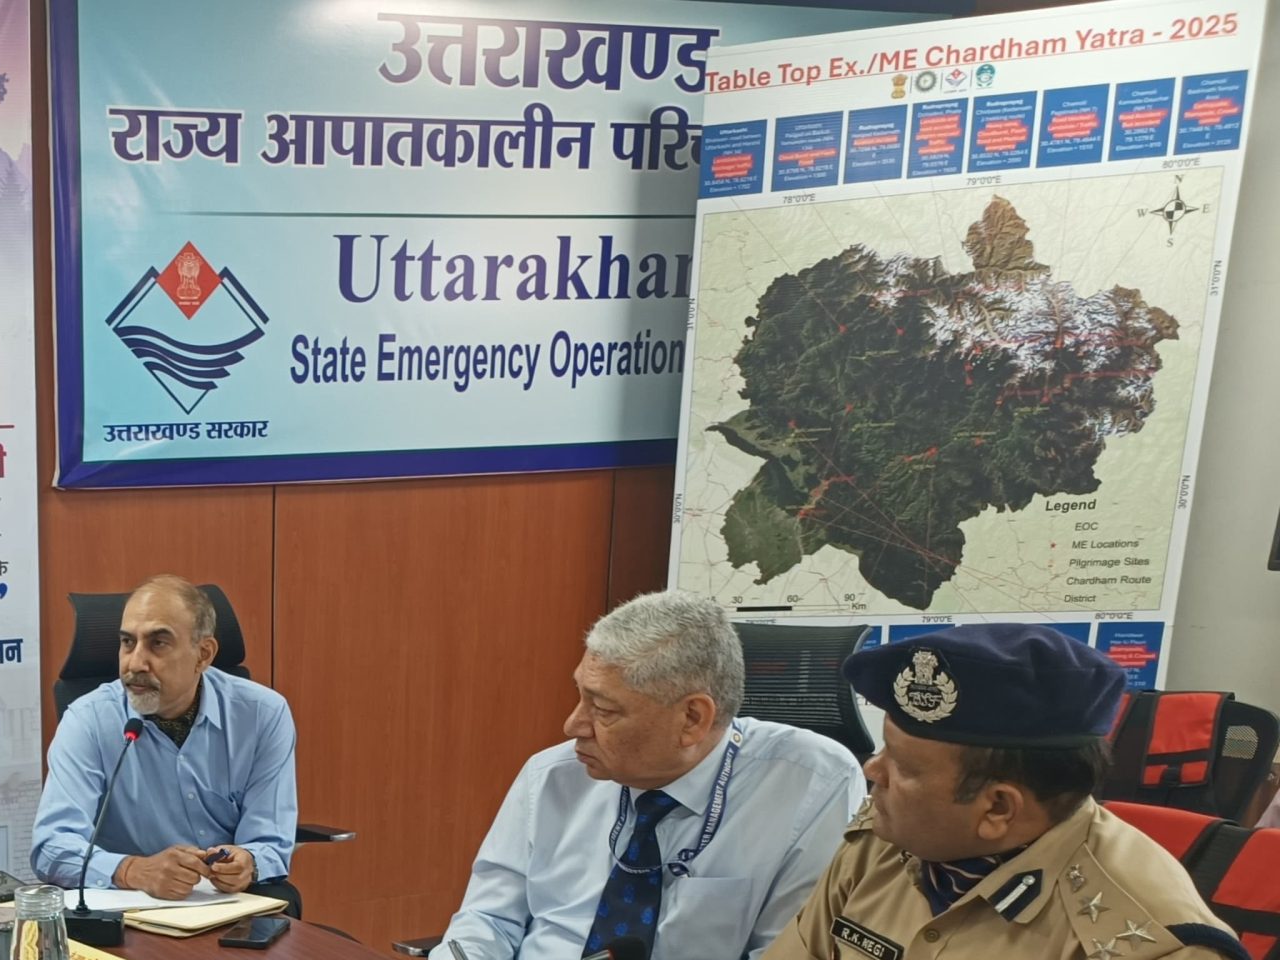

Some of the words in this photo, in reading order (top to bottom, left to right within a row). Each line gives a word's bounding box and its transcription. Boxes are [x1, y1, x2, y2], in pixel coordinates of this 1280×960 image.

[377, 13, 719, 92] उत्तराखण्ड
[705, 69, 771, 93] Table
[778, 63, 821, 85] Top
[829, 48, 918, 78] Ex./ME
[925, 36, 1067, 67] Chardham
[1075, 27, 1145, 51] Yatra
[1170, 13, 1238, 41] 2025
[108, 107, 242, 164] राज्य
[261, 103, 596, 170] आपातकालीन
[290, 334, 366, 385] State
[376, 333, 541, 393] Emergency
[102, 422, 202, 442] उत्तराखण्ड
[205, 420, 270, 440] सरकार
[1045, 499, 1097, 513] Legend
[1075, 522, 1099, 531] EOC
[1072, 541, 1087, 549] ME
[1091, 539, 1139, 549] Locations
[1070, 558, 1121, 568] Pilgrimage
[1124, 557, 1150, 566] Sites
[1066, 576, 1117, 586] Chardham
[1120, 575, 1152, 584] Route
[731, 596, 743, 604] 30
[844, 593, 856, 601] 90
[1064, 594, 1097, 603] District
[851, 602, 867, 611] Km
[704, 785, 726, 835] MANAGEMENT
[718, 747, 737, 787] AUTHORITY
